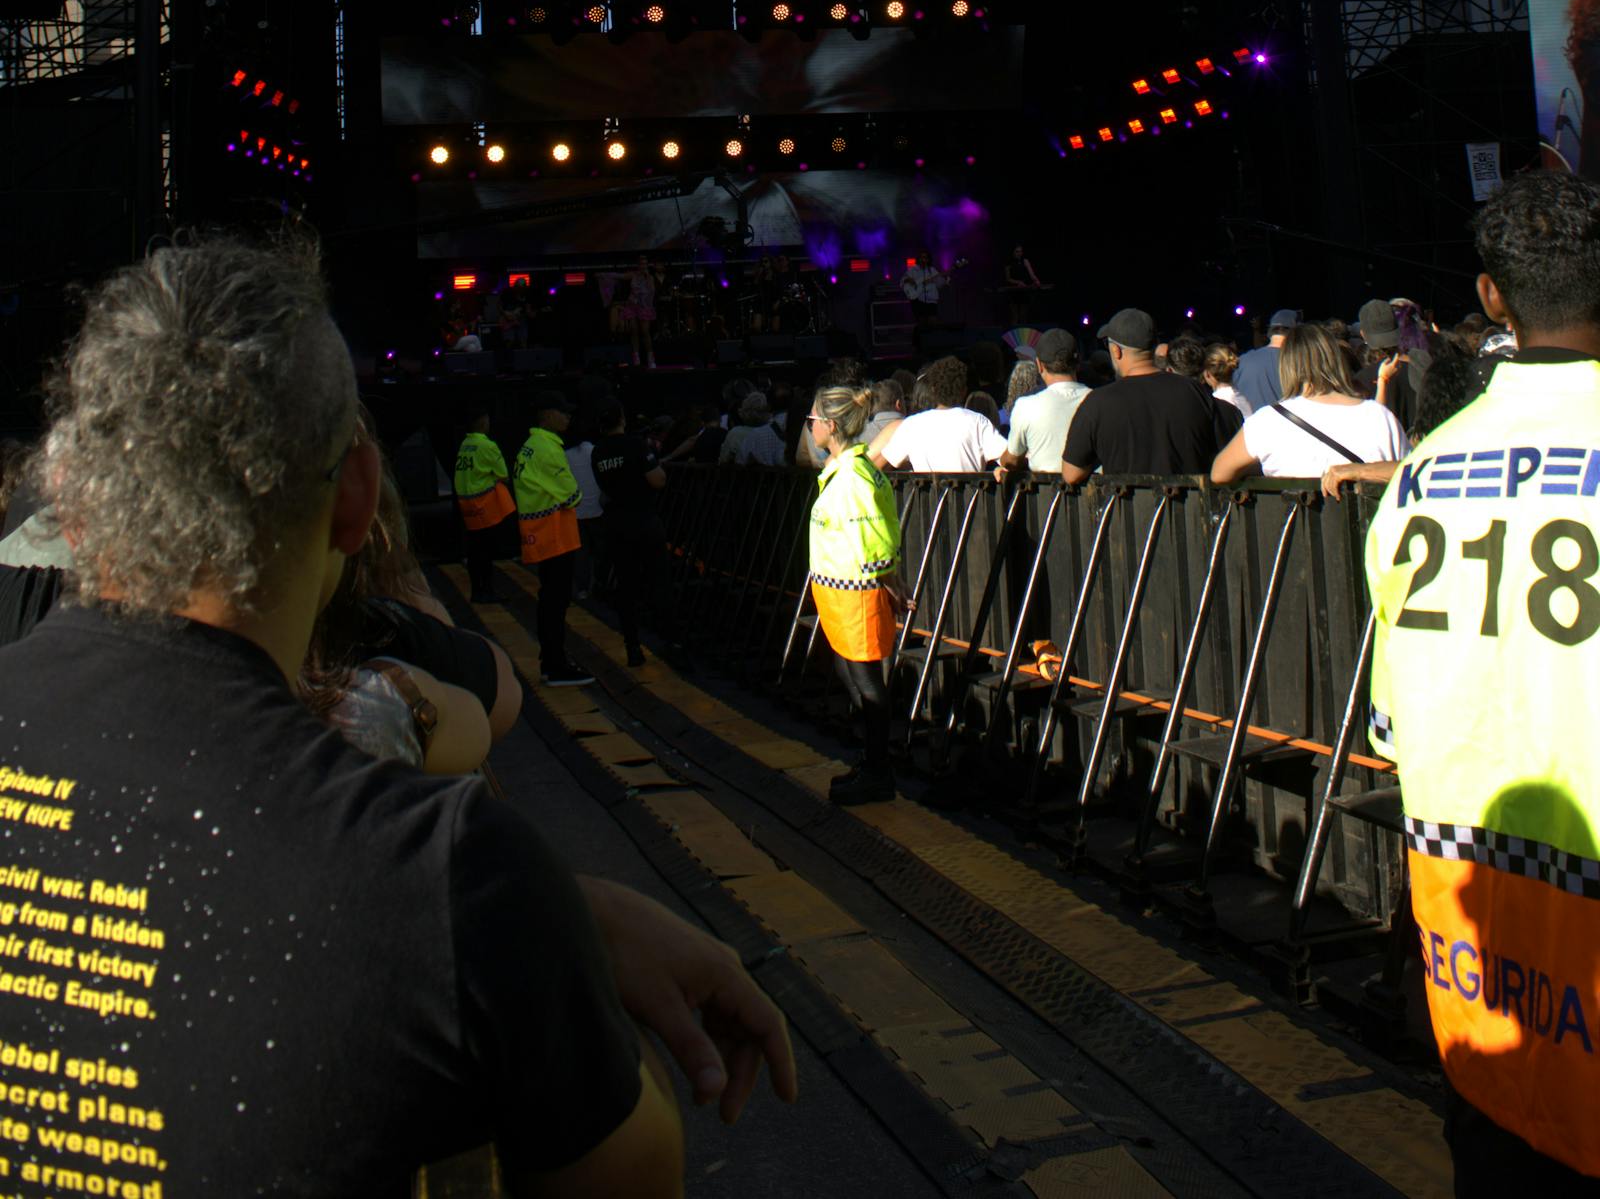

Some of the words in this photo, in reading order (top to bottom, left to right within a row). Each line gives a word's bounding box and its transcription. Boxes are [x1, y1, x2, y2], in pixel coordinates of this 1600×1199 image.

[597, 455, 625, 472] STAFF
[1393, 515, 1600, 646] 218
[53, 777, 77, 800] IV
[25, 803, 75, 830] HOPE
[42, 876, 85, 900] war.
[89, 880, 149, 912] Rebel
[19, 901, 69, 932] from
[72, 915, 88, 935] a
[91, 914, 165, 950] hidden
[28, 937, 75, 969] first
[78, 949, 158, 988] victory
[0, 966, 60, 1002] actic
[65, 980, 157, 1020] Empire.
[0, 1040, 60, 1075] ebel
[64, 1057, 139, 1090] spies
[0, 1116, 31, 1143] te
[78, 1094, 165, 1132] plans
[20, 1161, 164, 1199] armored
